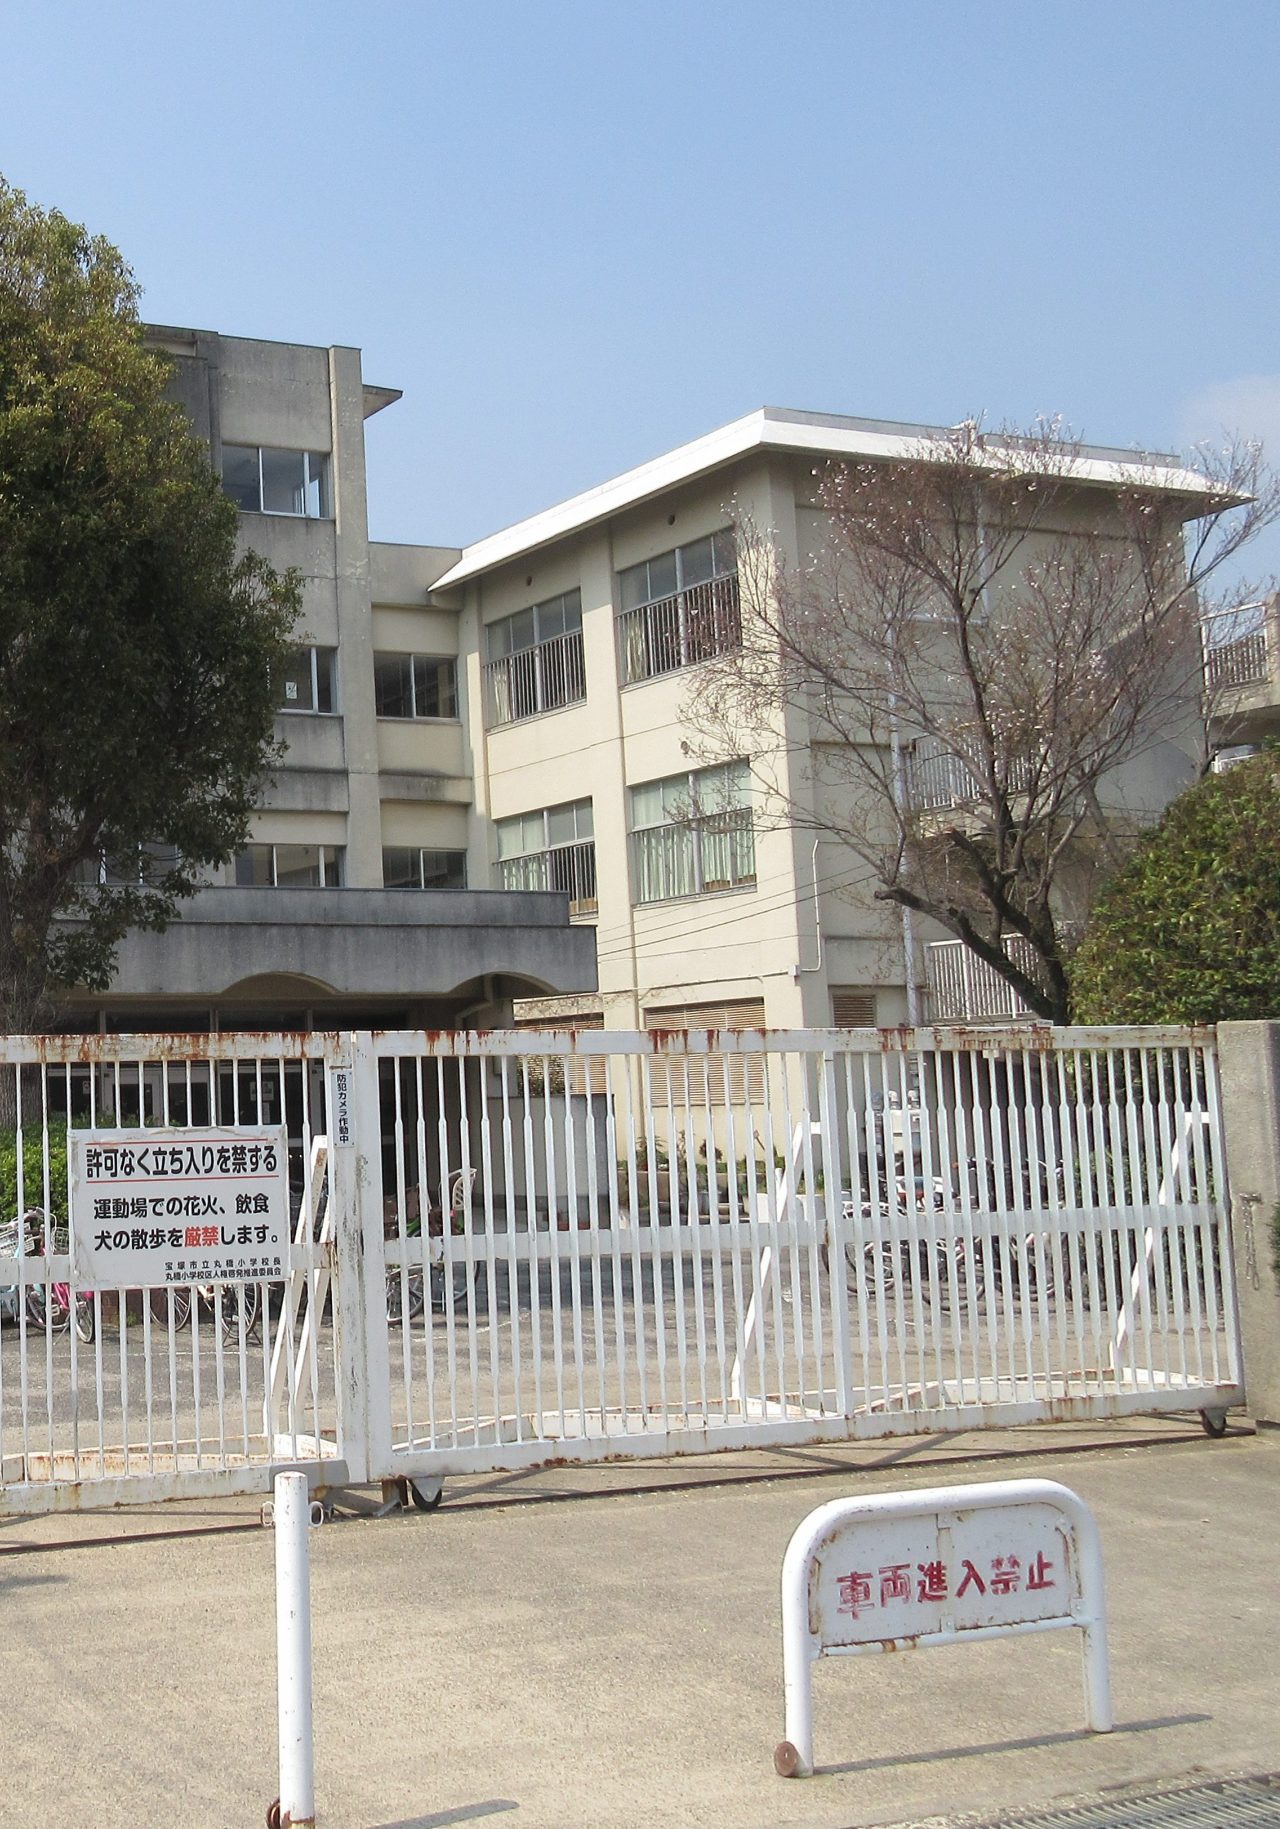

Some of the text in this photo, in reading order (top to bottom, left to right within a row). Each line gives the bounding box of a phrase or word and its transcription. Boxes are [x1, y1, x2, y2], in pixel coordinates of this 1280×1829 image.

[337, 1074, 349, 1143] 防犯カメラ作動中
[86, 1145, 277, 1178] 許可なく立ち入りを禁ずる
[94, 1192, 270, 1220] 運動場での花火、飲食
[94, 1224, 279, 1251] 犬の散歩を厳禁します。
[165, 1256, 281, 1271] 宝塚市立丸橋小学校長
[836, 1550, 1055, 1620] 車両進入禁止
